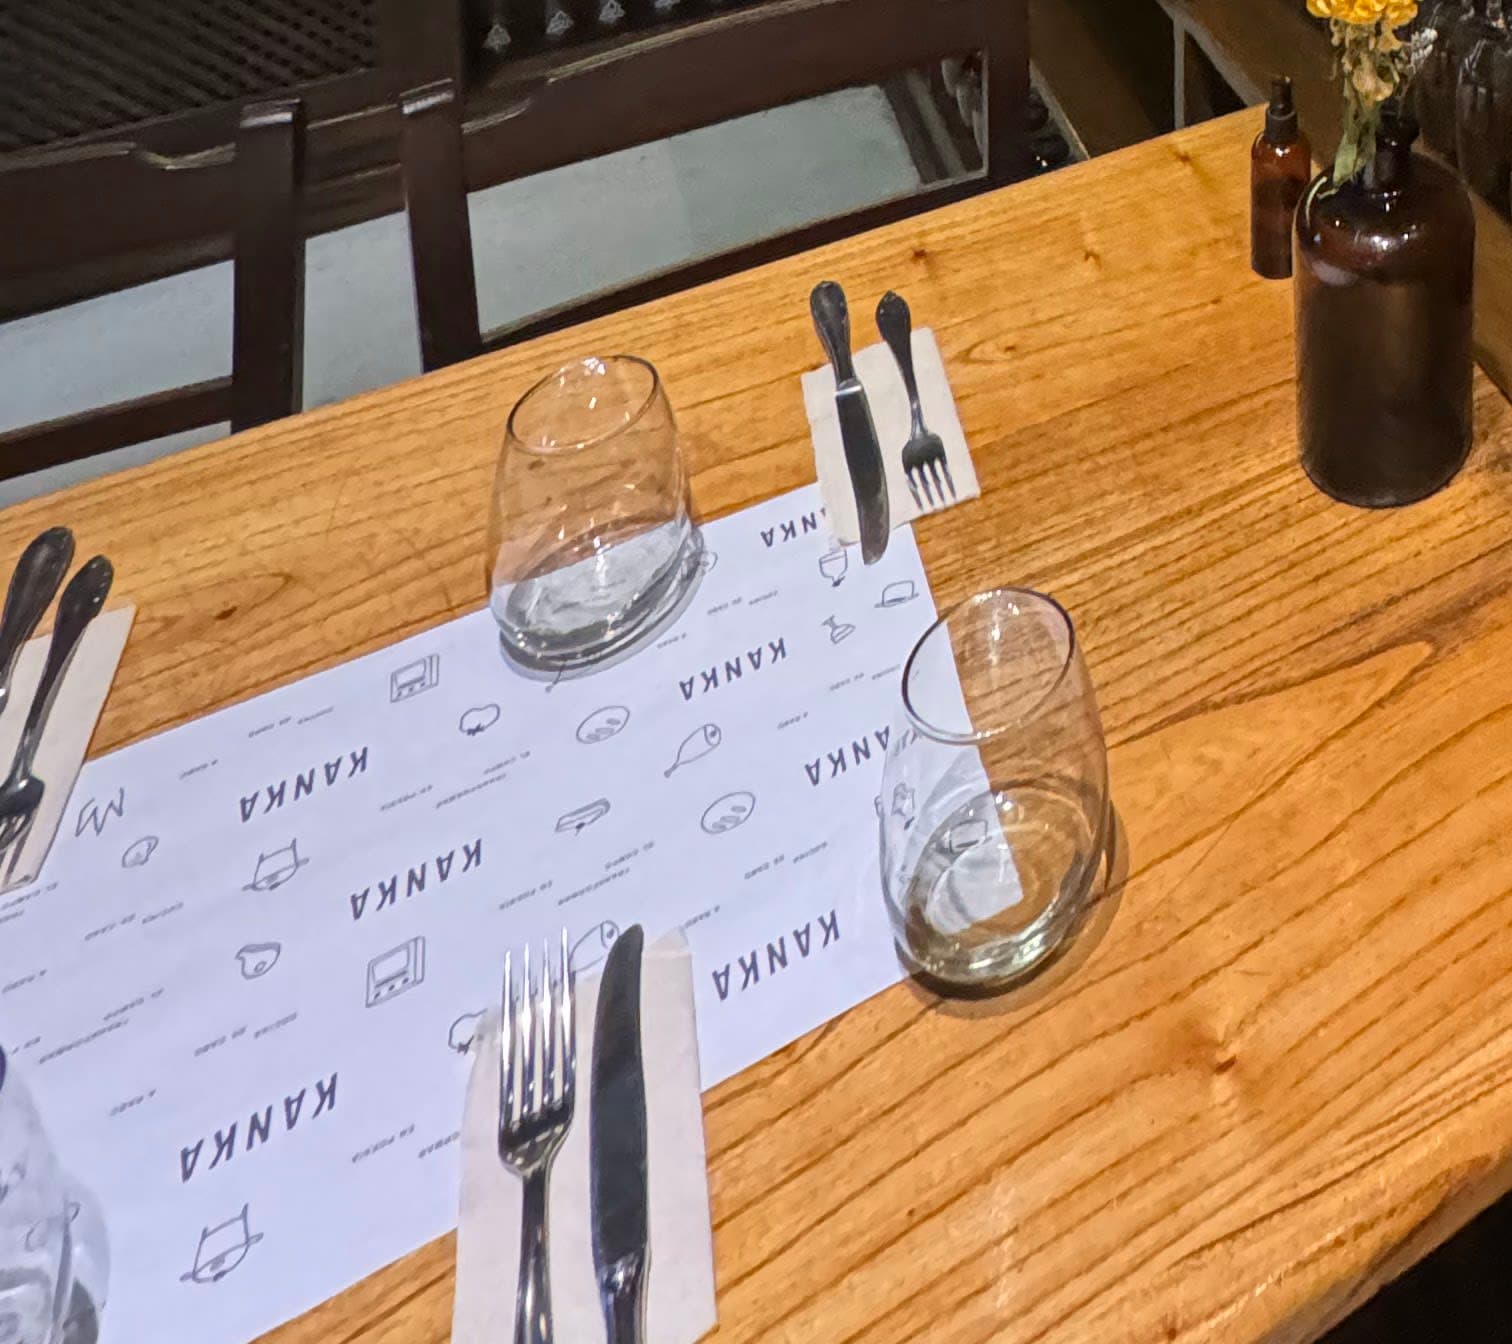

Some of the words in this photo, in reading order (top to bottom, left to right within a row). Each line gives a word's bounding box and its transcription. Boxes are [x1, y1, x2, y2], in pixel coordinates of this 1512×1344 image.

[760, 507, 826, 548] NKA
[679, 637, 787, 702] KANKA
[239, 746, 369, 824] KANKA
[350, 838, 482, 921] KANKA
[711, 907, 841, 1002] KANKA
[180, 1071, 338, 1184] KANKA
